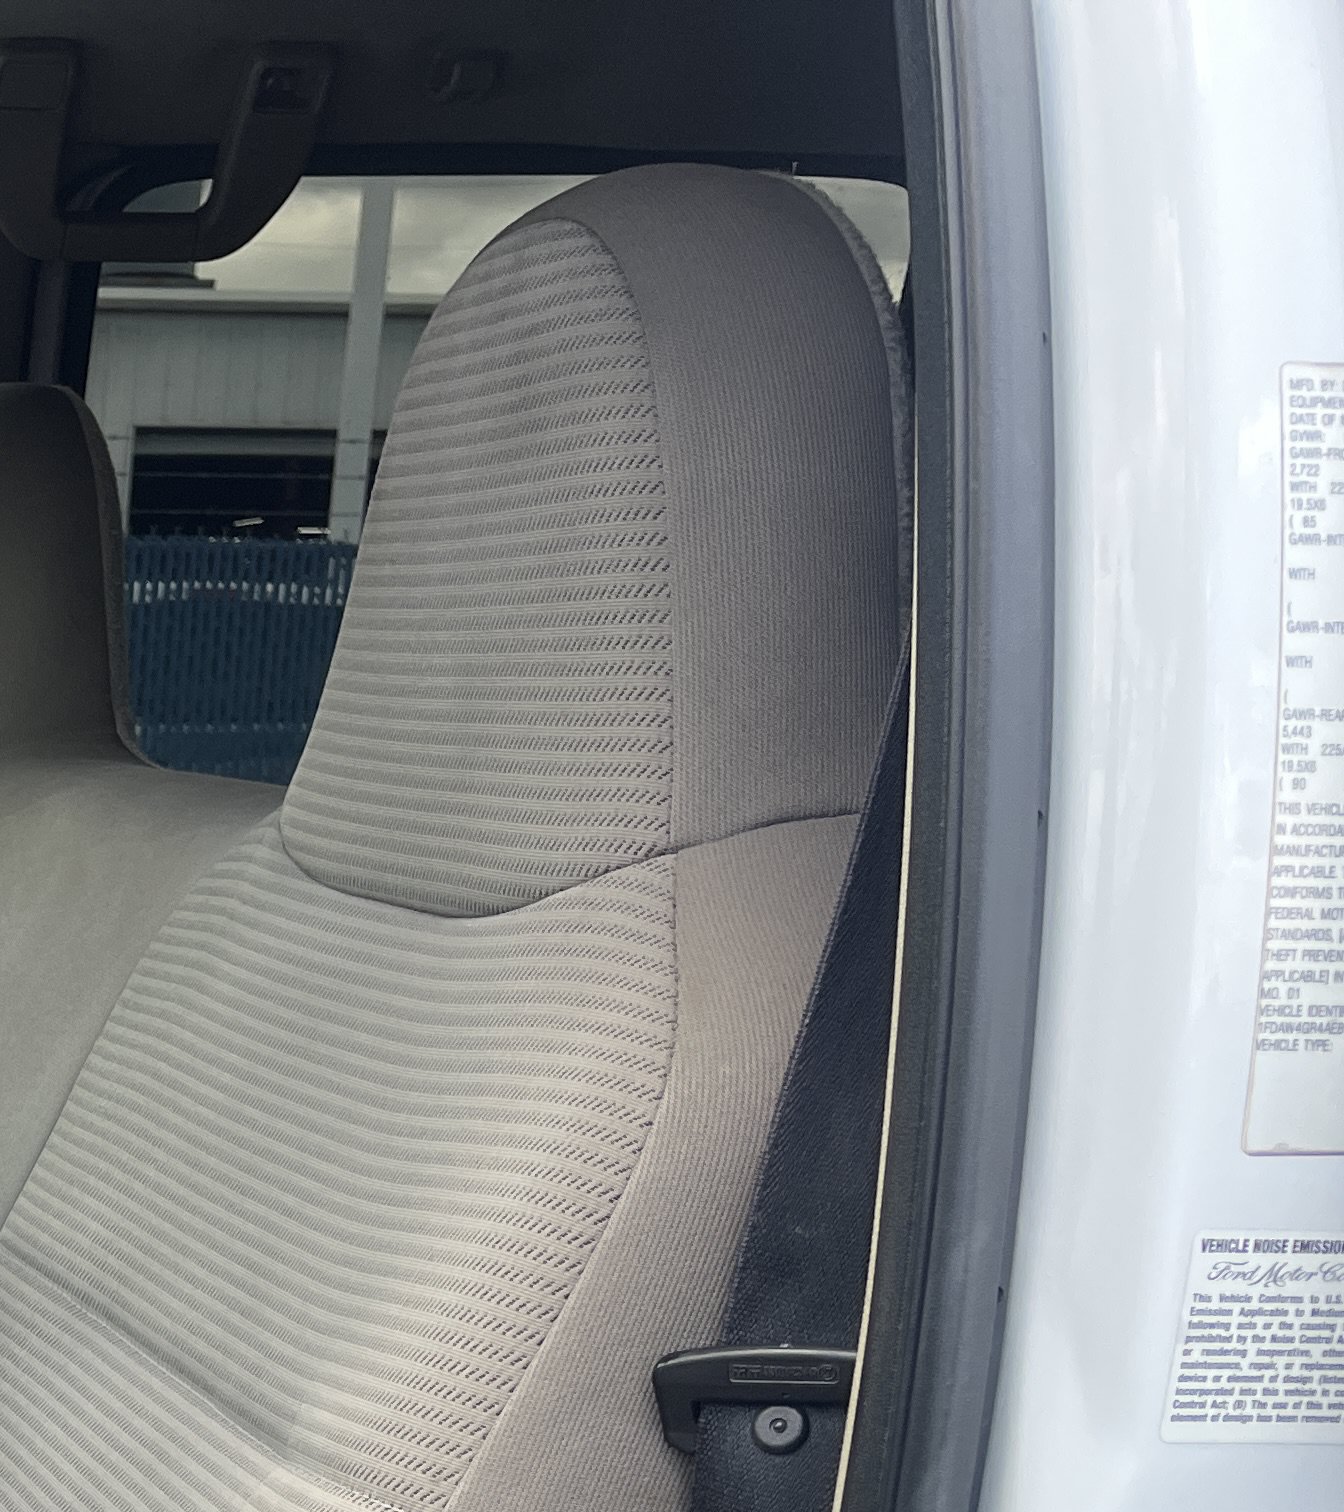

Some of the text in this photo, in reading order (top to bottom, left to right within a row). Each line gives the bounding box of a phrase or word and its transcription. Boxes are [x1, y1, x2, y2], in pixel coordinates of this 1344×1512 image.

[1289, 412, 1317, 426] DATE
[1321, 413, 1336, 426] OF
[1289, 480, 1317, 494] WITH
[1288, 567, 1315, 580] WITH
[1285, 655, 1313, 669] WITH
[1280, 743, 1309, 756] WITH
[1291, 777, 1306, 790] 90
[1278, 802, 1301, 815] THIS
[1276, 823, 1286, 836] IN
[1272, 865, 1337, 879] APPLICABLE
[1270, 886, 1333, 900] CONFORMS
[1268, 907, 1315, 920] FEDERAL
[1264, 949, 1297, 962] THEFT
[1259, 1004, 1303, 1017] VEHICLE
[1256, 1039, 1300, 1052] VEHICLE
[1201, 1239, 1250, 1254] VEHICLE
[1253, 1239, 1289, 1254] NOISE
[1207, 1261, 1261, 1281] Ford
[1248, 1261, 1318, 1288] Motor
[1193, 1292, 1212, 1303] This
[1219, 1293, 1253, 1303] Vehicle
[1258, 1293, 1304, 1304] Conforms
[1310, 1293, 1320, 1304] to
[1190, 1307, 1233, 1317] Emission
[1238, 1307, 1289, 1318] Applicable
[1295, 1307, 1305, 1317] to
[1188, 1320, 1232, 1331] following
[1299, 1321, 1337, 1332] causing
[1184, 1334, 1234, 1345] prohibited
[1236, 1334, 1248, 1345] by
[1252, 1334, 1266, 1343] the
[1270, 1335, 1296, 1343] Noise
[1299, 1334, 1335, 1344] Control
[1201, 1348, 1248, 1358] rendering
[1177, 1374, 1208, 1383] device
[1282, 1374, 1314, 1385] design
[1172, 1400, 1207, 1410] Control
[1251, 1400, 1268, 1410] The
